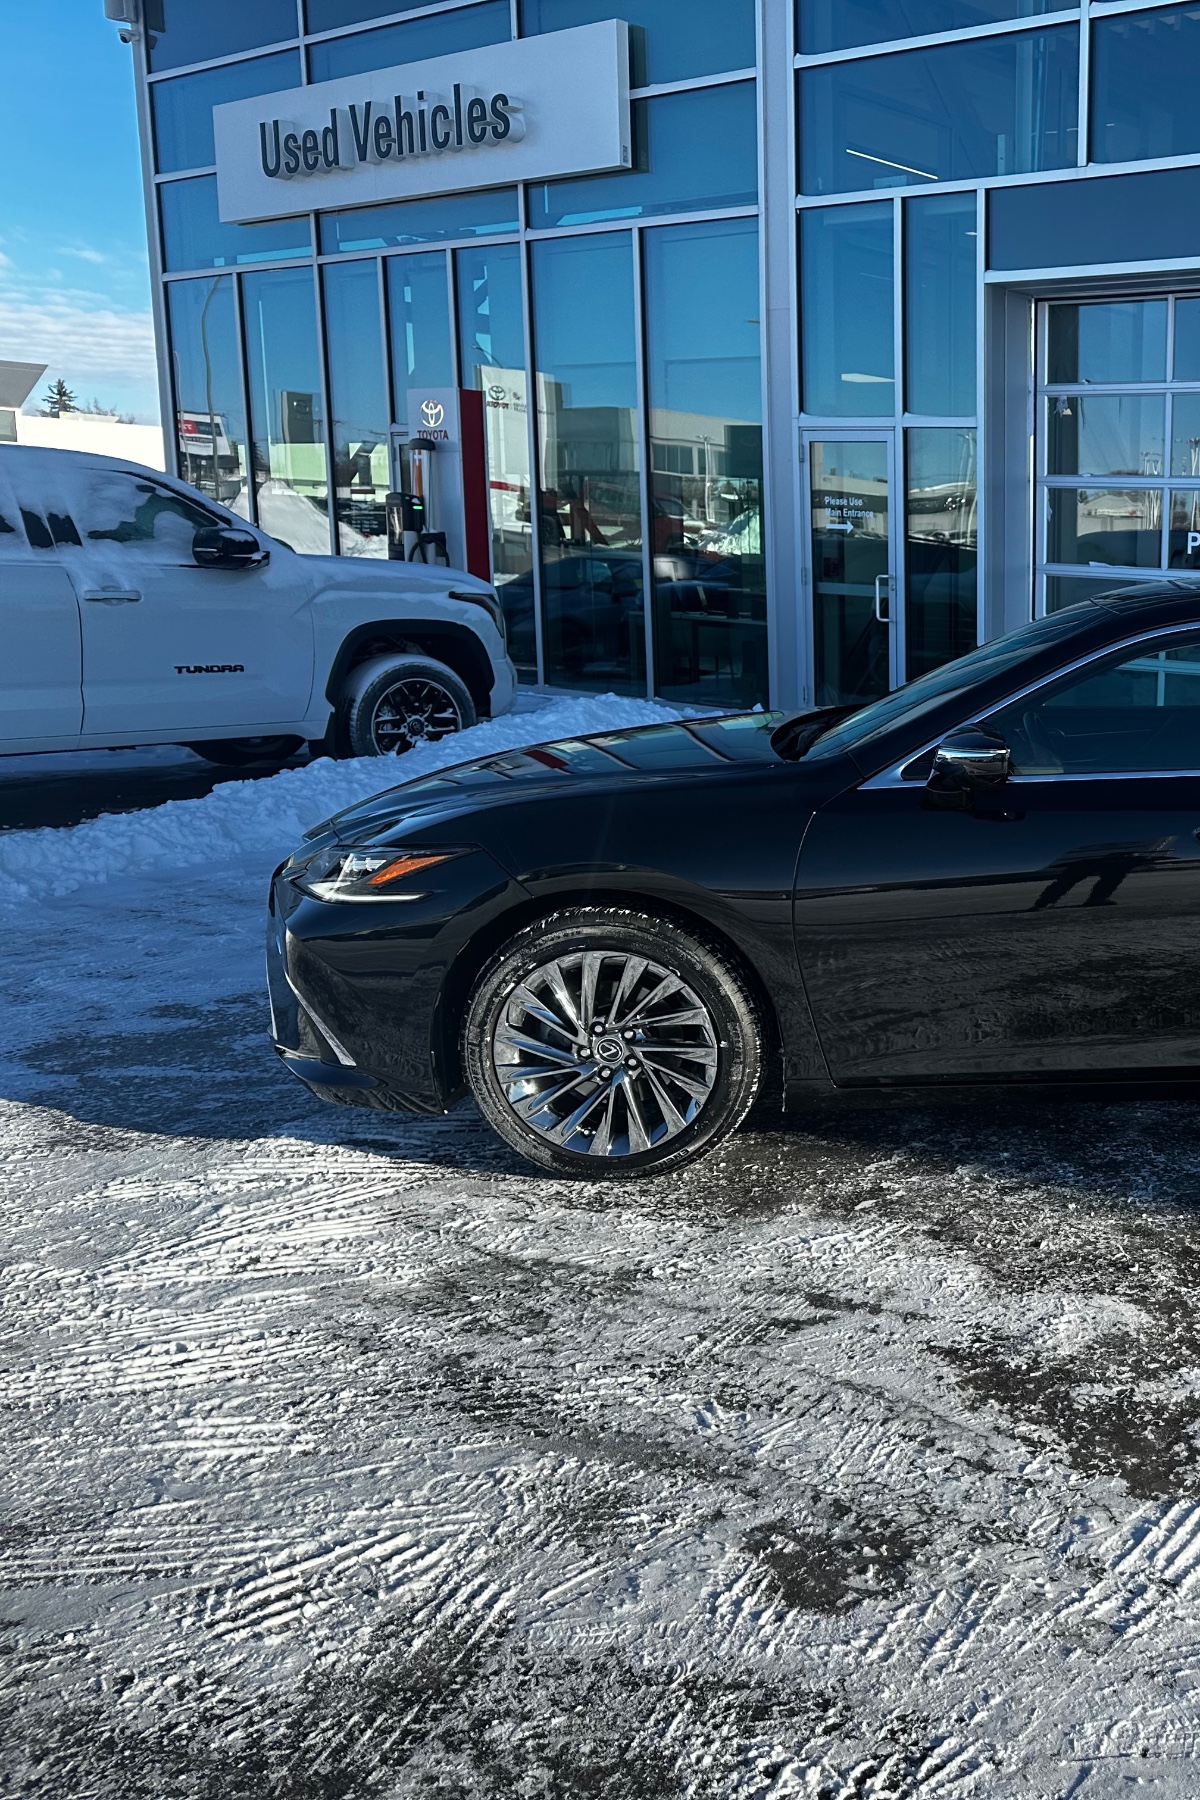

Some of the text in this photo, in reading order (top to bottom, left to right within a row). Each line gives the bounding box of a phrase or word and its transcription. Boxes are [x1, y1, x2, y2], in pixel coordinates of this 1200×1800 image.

[259, 83, 511, 178] Used Vehicles
[417, 429, 449, 440] TOYOTA
[824, 495, 863, 506] Please Use
[825, 508, 874, 519] Main Entrance
[173, 664, 245, 675] TUNDRA
